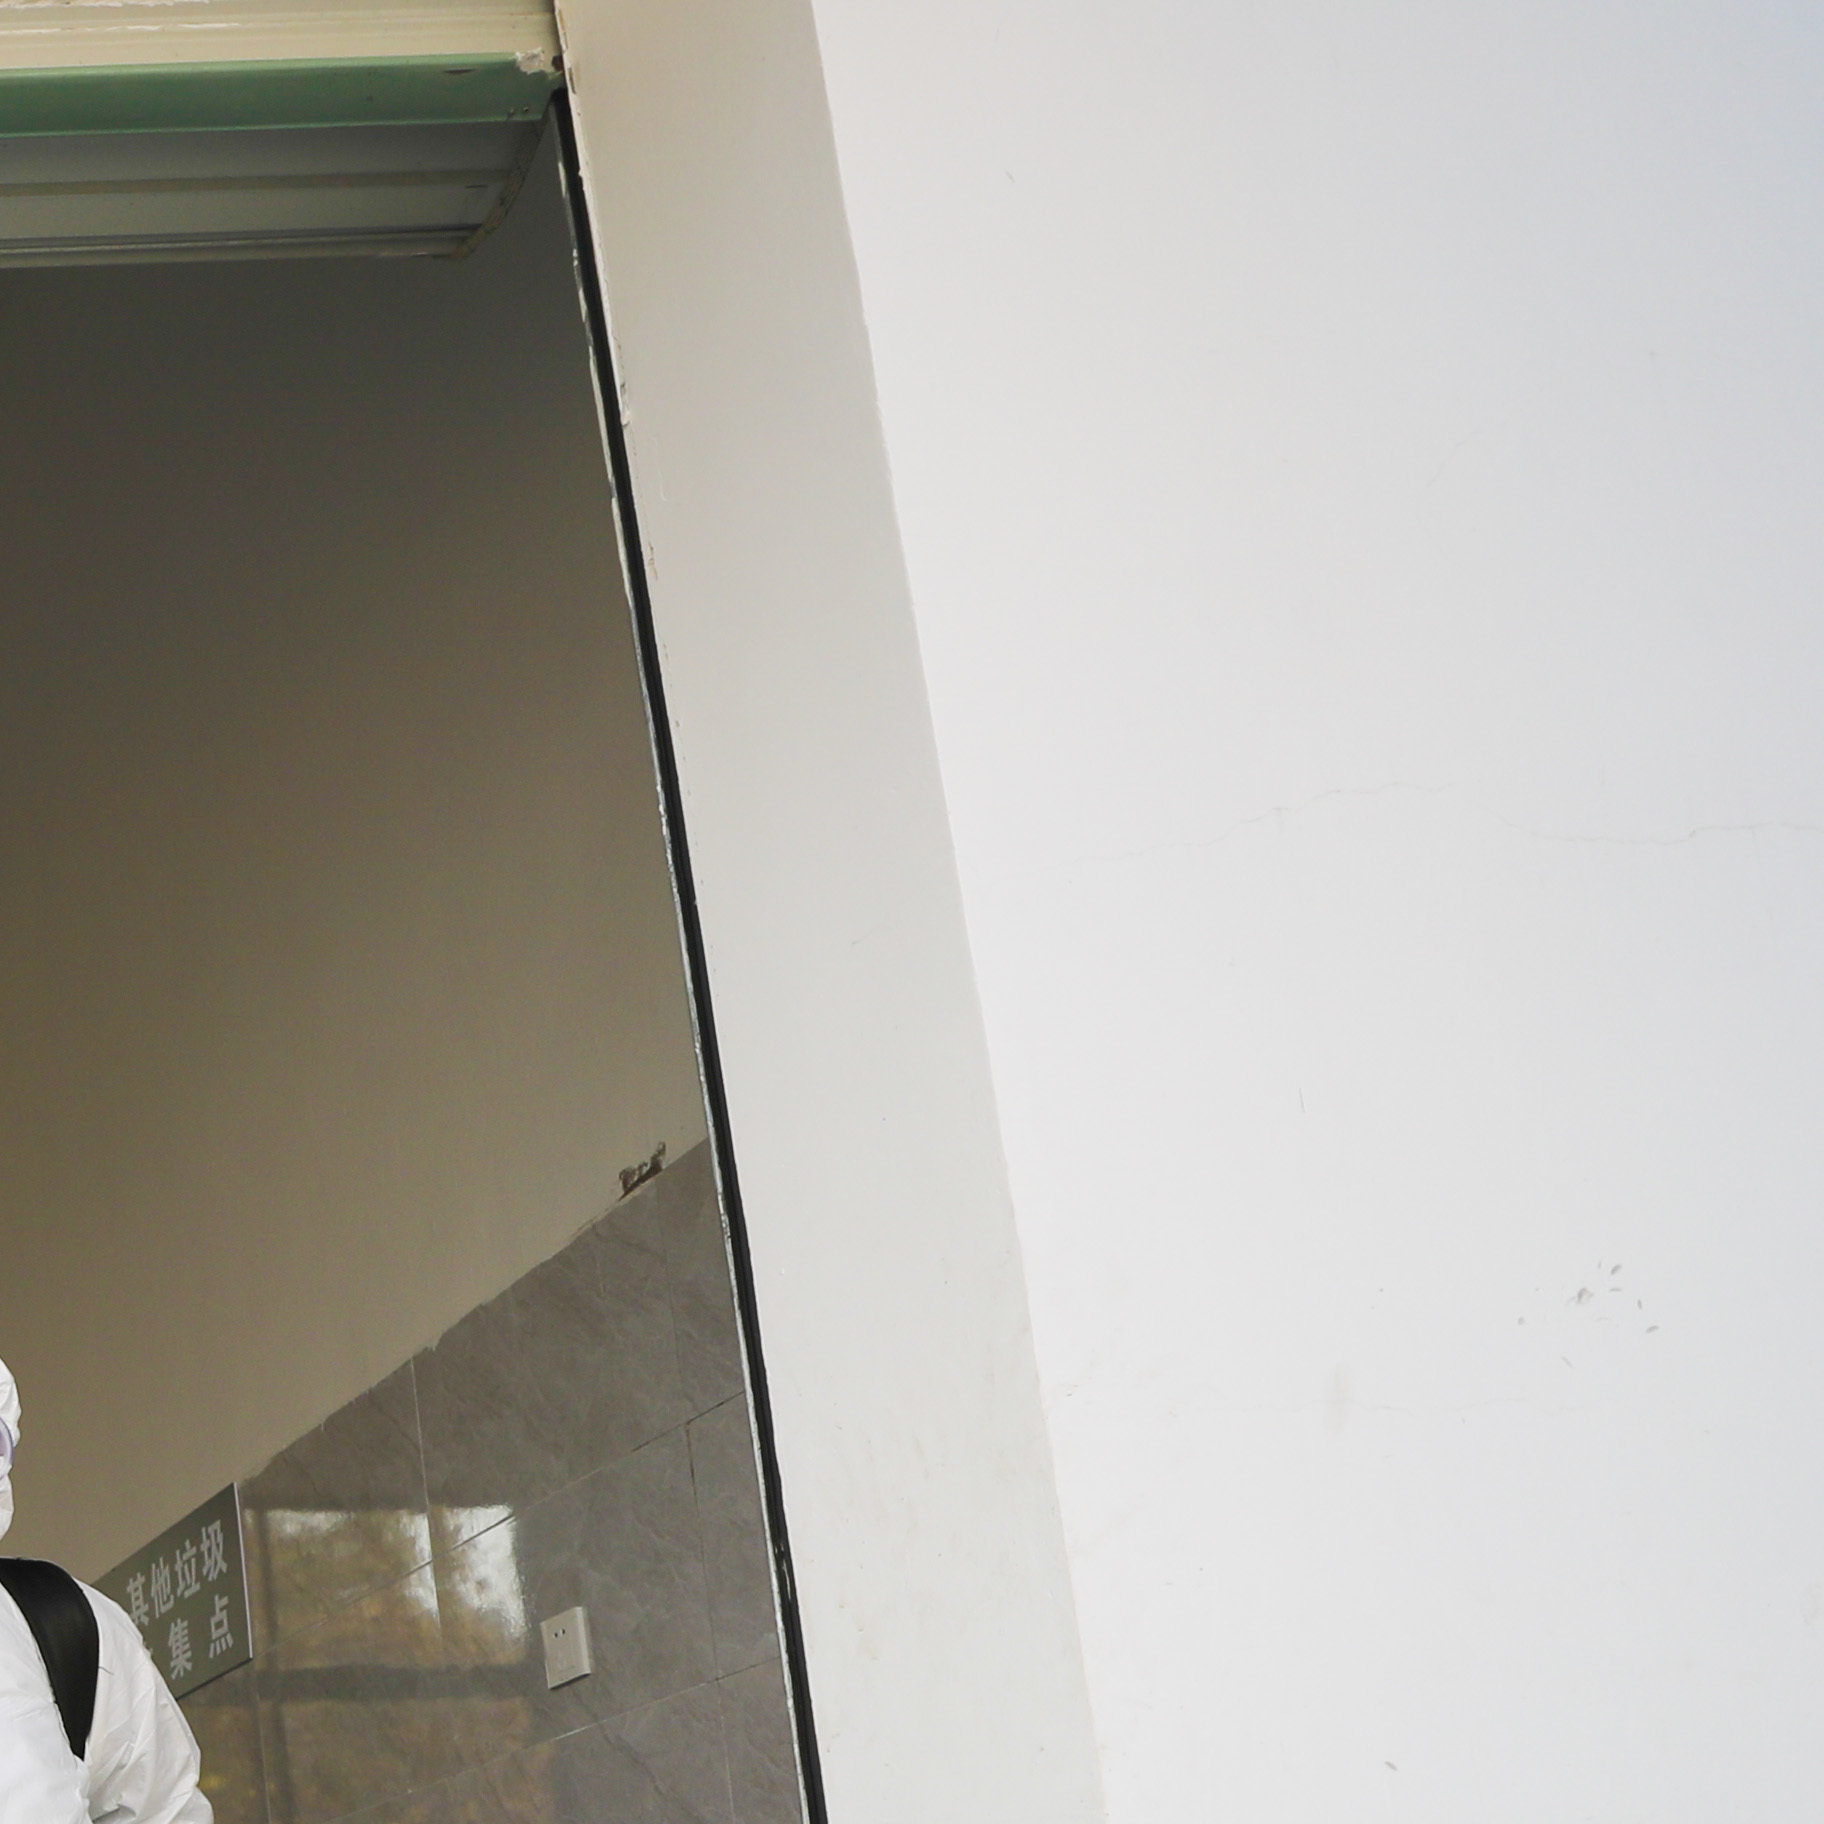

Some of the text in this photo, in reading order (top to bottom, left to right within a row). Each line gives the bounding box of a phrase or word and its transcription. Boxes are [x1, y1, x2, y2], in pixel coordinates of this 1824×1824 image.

[125, 1519, 229, 1628] 其他垃圾
[143, 1594, 234, 1681] 集点
